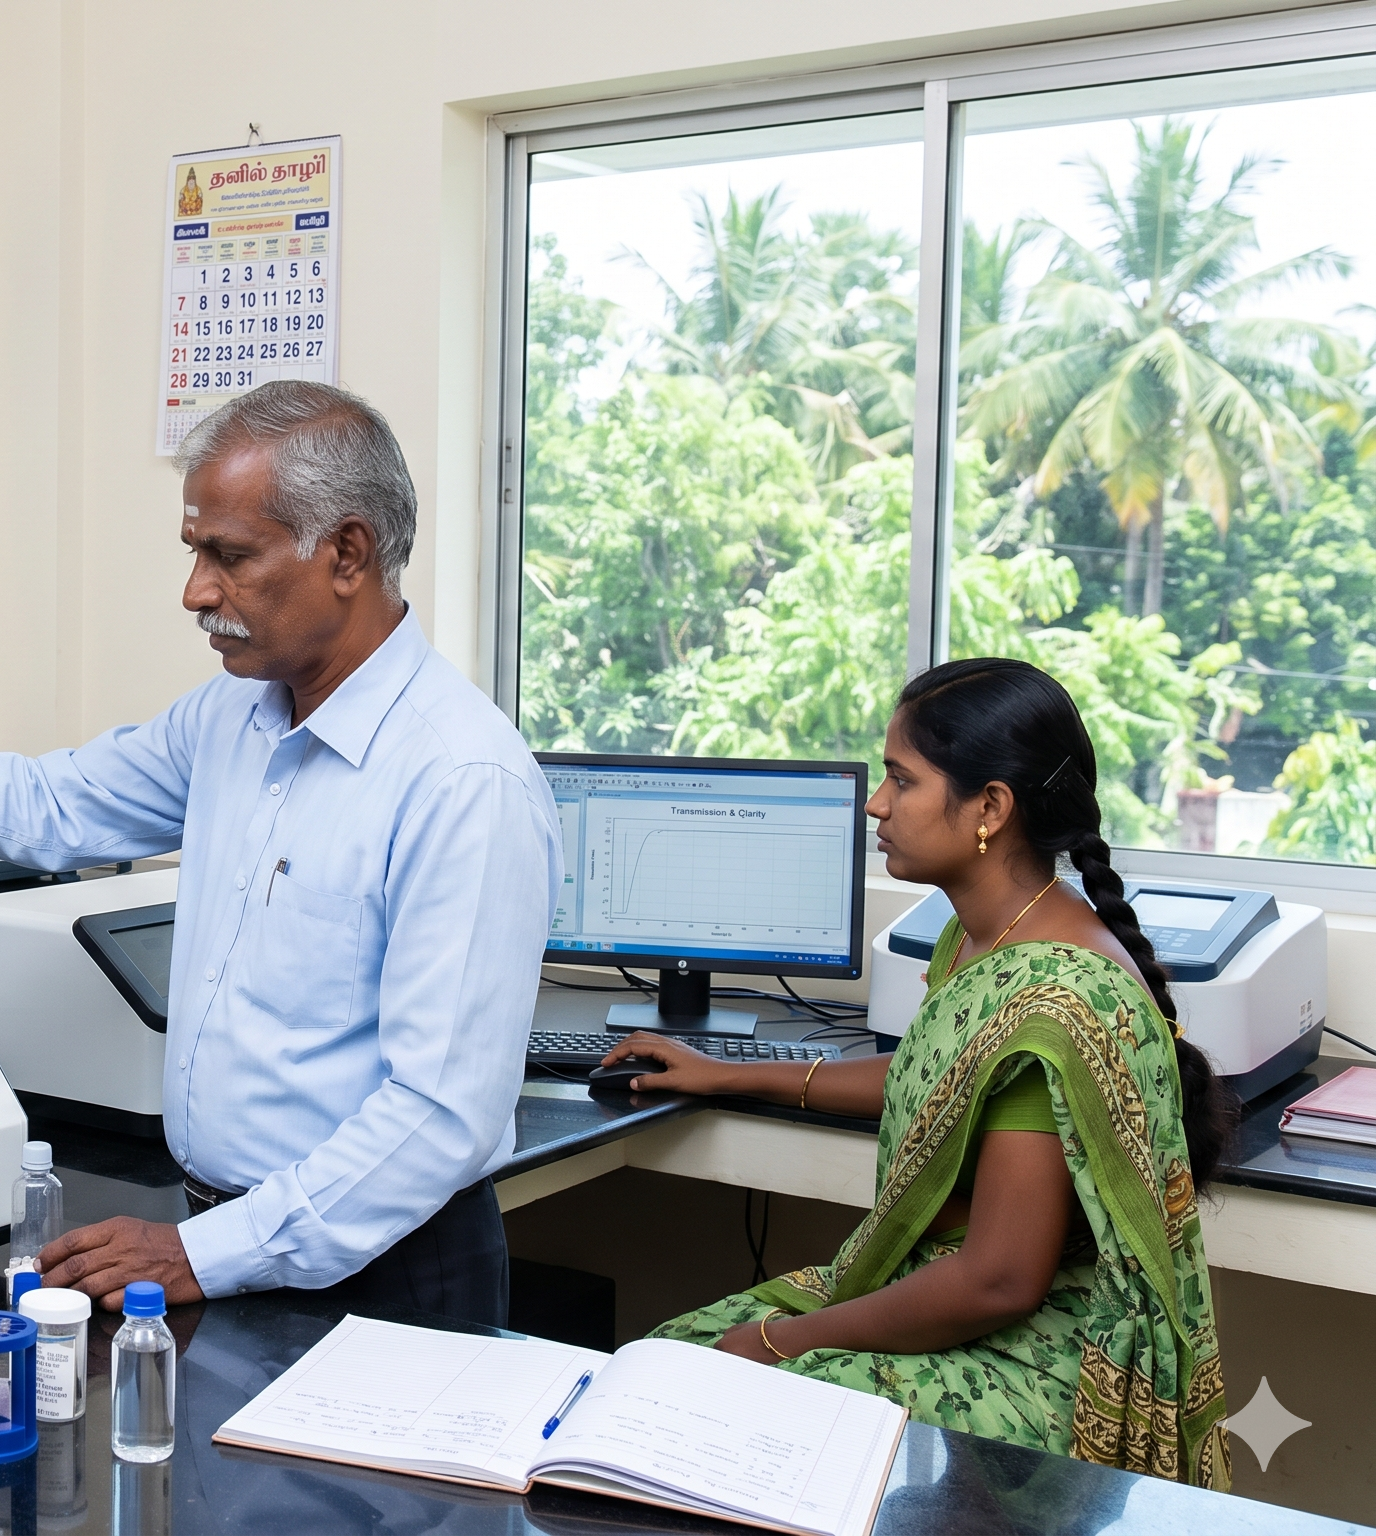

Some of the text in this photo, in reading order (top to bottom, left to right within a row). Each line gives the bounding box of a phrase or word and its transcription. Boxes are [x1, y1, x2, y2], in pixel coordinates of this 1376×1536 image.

[201, 260, 321, 285] 1 2 3 4 5 6
[177, 287, 324, 312] 7 8 9 10 11 12 13
[173, 313, 324, 337] 14 15 16 17 18 19 20
[171, 340, 323, 363] 21 22 23 24 25 26 27
[170, 370, 252, 389] 28 29 30 31
[671, 806, 766, 820] Transmission & Clarity
